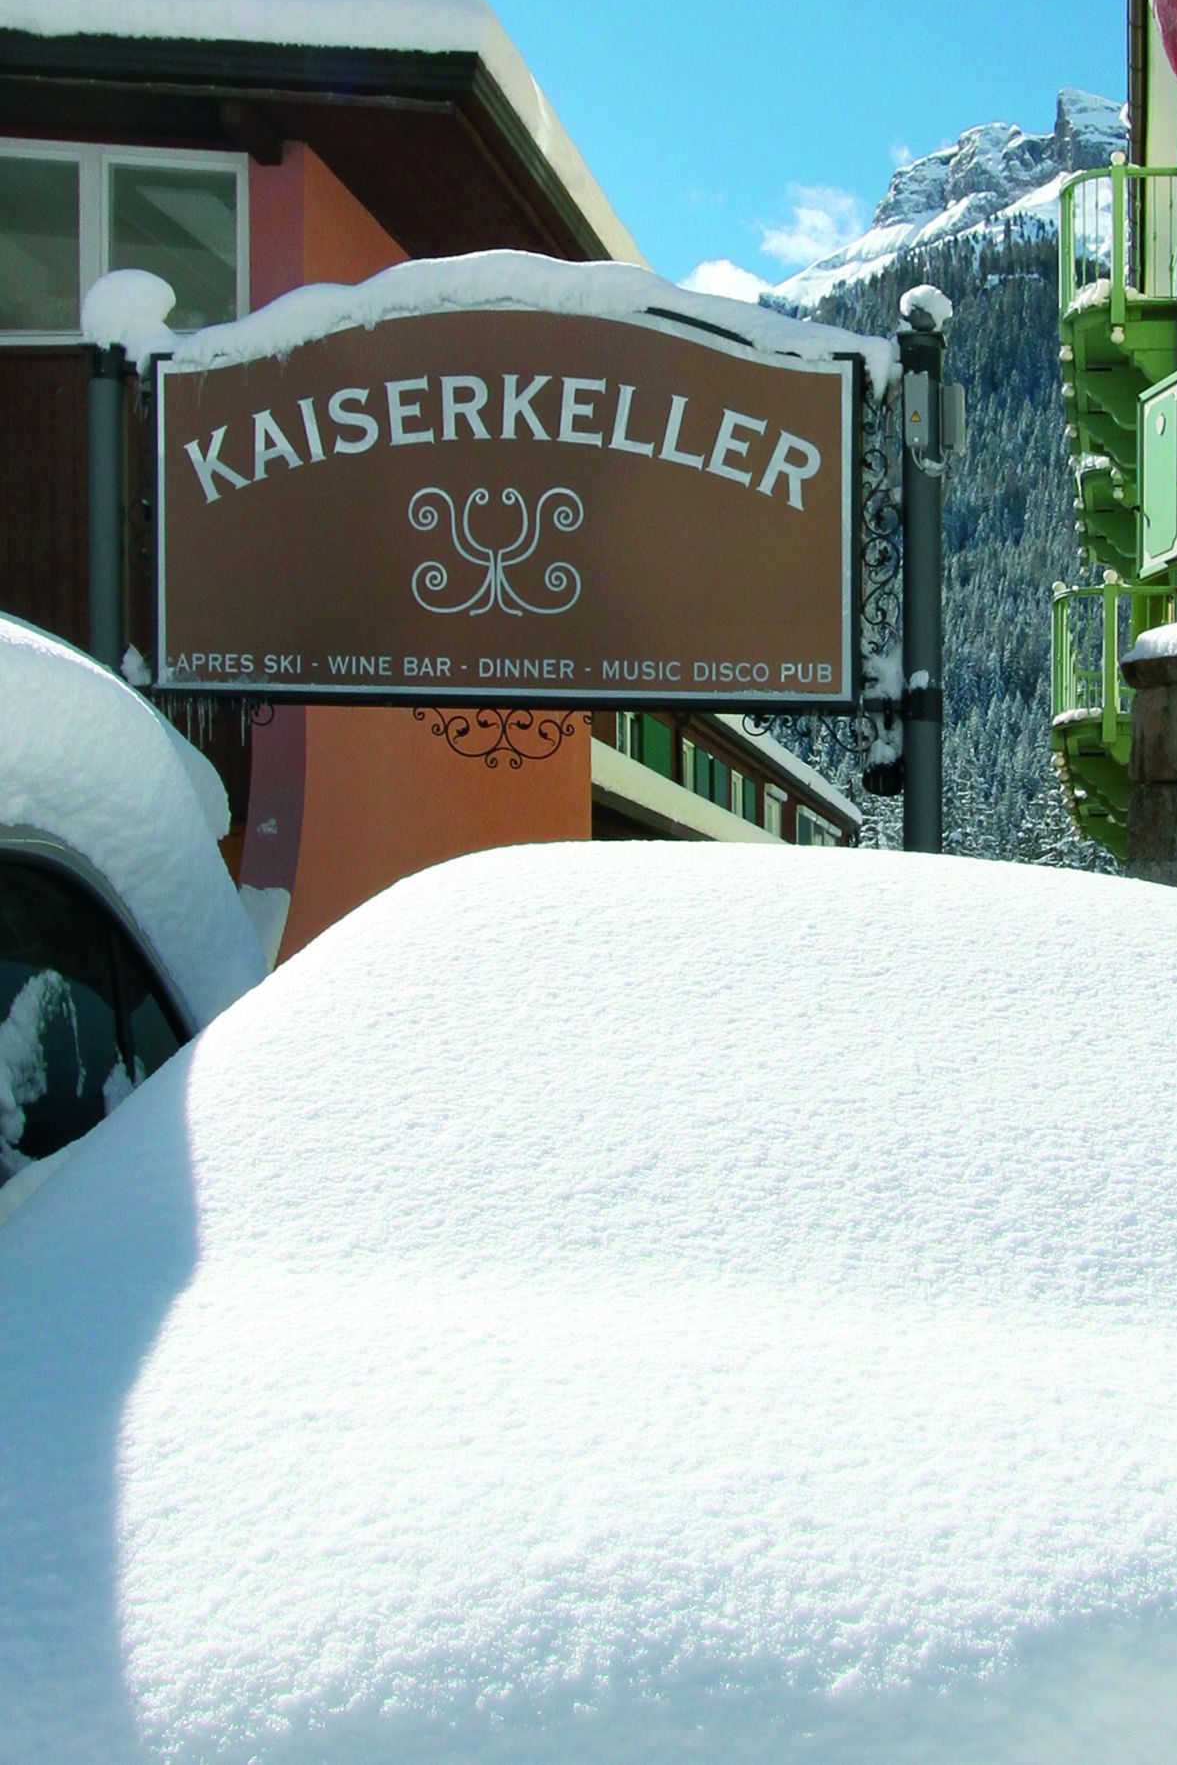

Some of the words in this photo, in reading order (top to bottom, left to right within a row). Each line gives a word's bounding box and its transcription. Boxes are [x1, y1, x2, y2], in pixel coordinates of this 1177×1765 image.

[183, 374, 822, 512] KAISERKELLER
[176, 653, 254, 674] APRES
[264, 654, 302, 675] SKI
[327, 655, 393, 676] WINE
[403, 657, 452, 678] BAR
[478, 658, 575, 680] DINNER
[602, 660, 681, 681] MUSIC
[693, 662, 770, 683] DISCO
[780, 663, 833, 683] PUB
